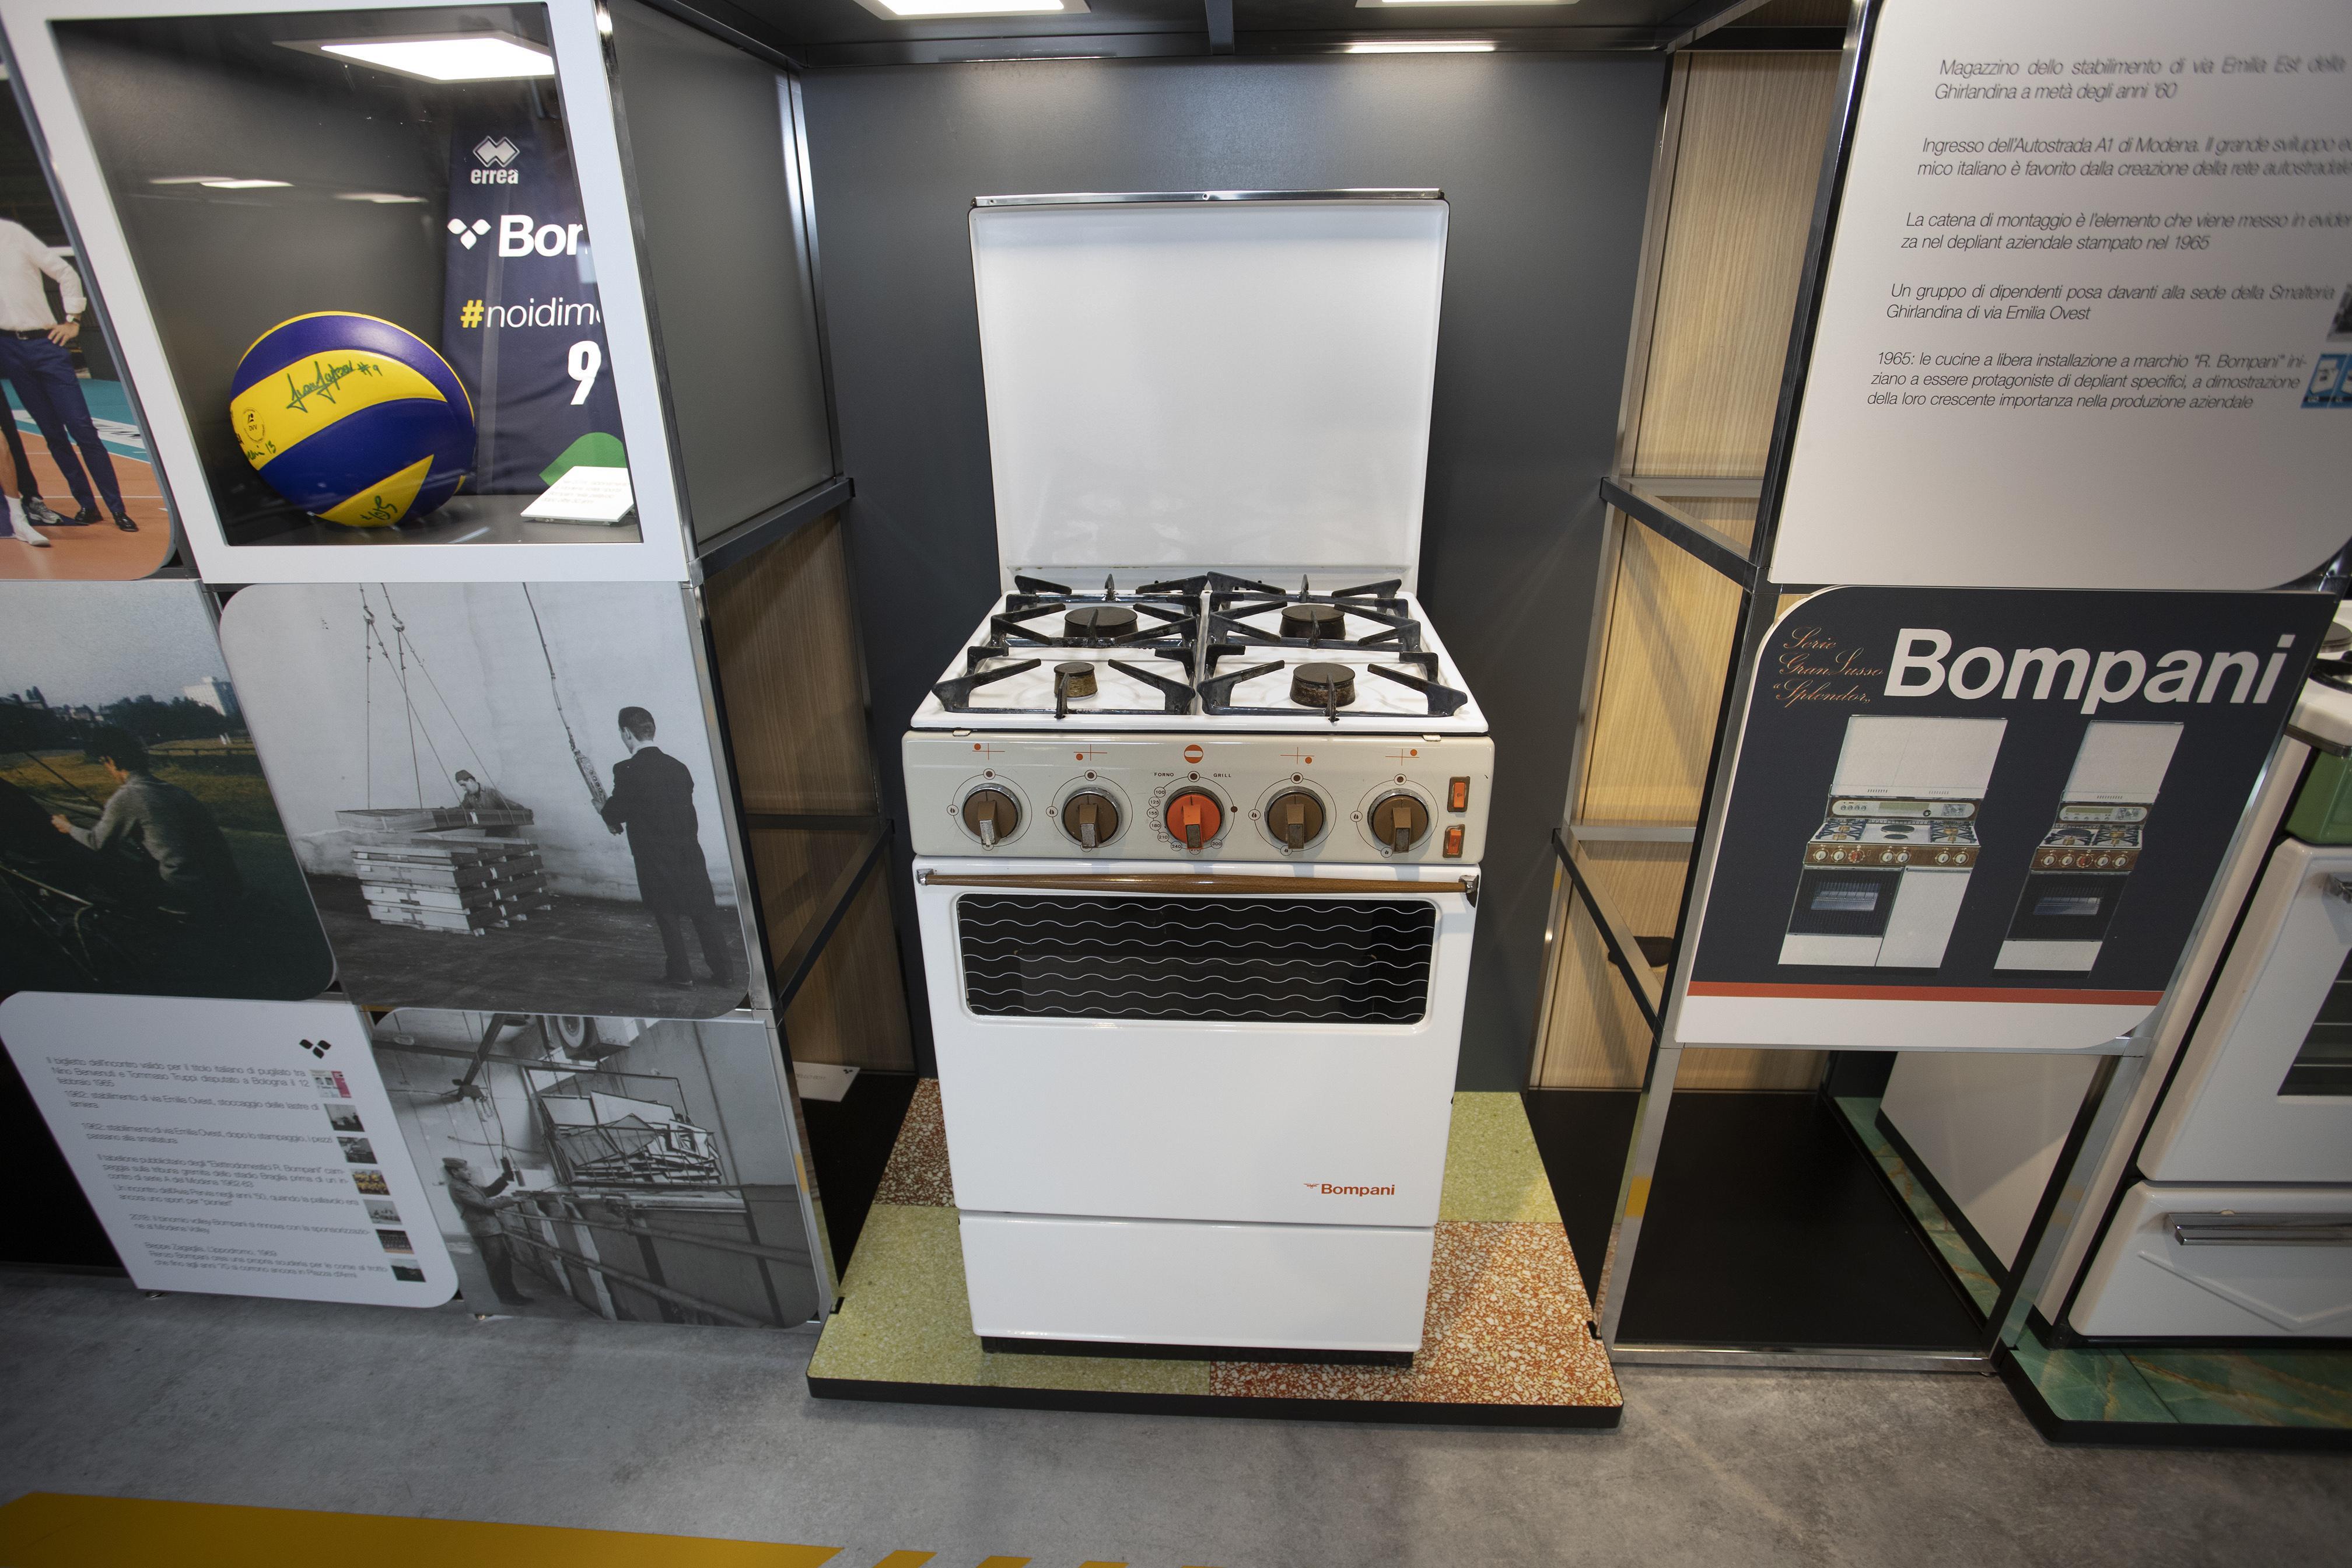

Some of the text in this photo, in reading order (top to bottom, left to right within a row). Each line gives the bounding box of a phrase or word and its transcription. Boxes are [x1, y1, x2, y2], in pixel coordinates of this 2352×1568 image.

[1940, 59, 2021, 79] Magazzino
[2028, 58, 2064, 75] dello
[2071, 58, 2163, 75] stabilimento
[2169, 58, 2187, 75] di
[2193, 57, 2215, 75] via
[1935, 83, 2179, 103] Ghirlandina a metà degli anni '60
[1923, 138, 1985, 156] Ingresso
[1988, 137, 2093, 153] dell'Autostrada
[2094, 137, 2115, 153] A1
[2118, 137, 2134, 153] di
[2135, 136, 2200, 153] Modena.
[2205, 136, 2216, 152] Il
[1917, 160, 1954, 176] mico
[1957, 160, 2007, 176] italiano
[2011, 160, 2021, 176] è
[2025, 160, 2077, 176] favorito
[2080, 160, 2115, 176] dalla
[2118, 161, 2190, 177] creazione
[2192, 160, 2228, 177] della
[1906, 212, 1925, 228] La
[1928, 214, 1977, 228] catena
[1980, 213, 1994, 228] di
[1996, 213, 2073, 231] montaggio
[2076, 212, 2087, 228] è
[2089, 212, 2162, 228] l'elemento
[2164, 212, 2193, 228] che
[2197, 212, 2236, 228] viene
[1901, 235, 2211, 253] za nel depliant aziendale stampato nel 1965
[1891, 283, 1912, 298] Un
[1916, 287, 1968, 302] gruppo
[1972, 284, 1986, 298] di
[1990, 284, 2064, 302] dipendenti
[2066, 288, 2104, 302] posa
[2107, 285, 2160, 300] davanti
[2161, 285, 2186, 300] alla
[2190, 285, 2227, 300] sede
[460, 297, 601, 328] #noidim
[1887, 304, 2092, 320] Ghirlandina di via Emilia Ovest
[1879, 352, 1916, 366] 1965:
[1919, 352, 1932, 366] le
[1935, 352, 1981, 366] cucine
[1983, 356, 1994, 366] a
[1996, 353, 2034, 367] libera
[2036, 353, 2118, 368] installazione
[2120, 357, 2131, 368] a
[2133, 354, 2189, 368] marchio
[567, 340, 601, 405] 9
[1871, 372, 2301, 391] ziano a essere protagoniste di depliant specifici, a dimostrazione
[1867, 392, 2254, 411] della loro crescente importanza nella produzione aziendale
[1779, 653, 1831, 676] Gran
[1884, 628, 2295, 715] Bompani
[1321, 1184, 1395, 1196] Bompani
